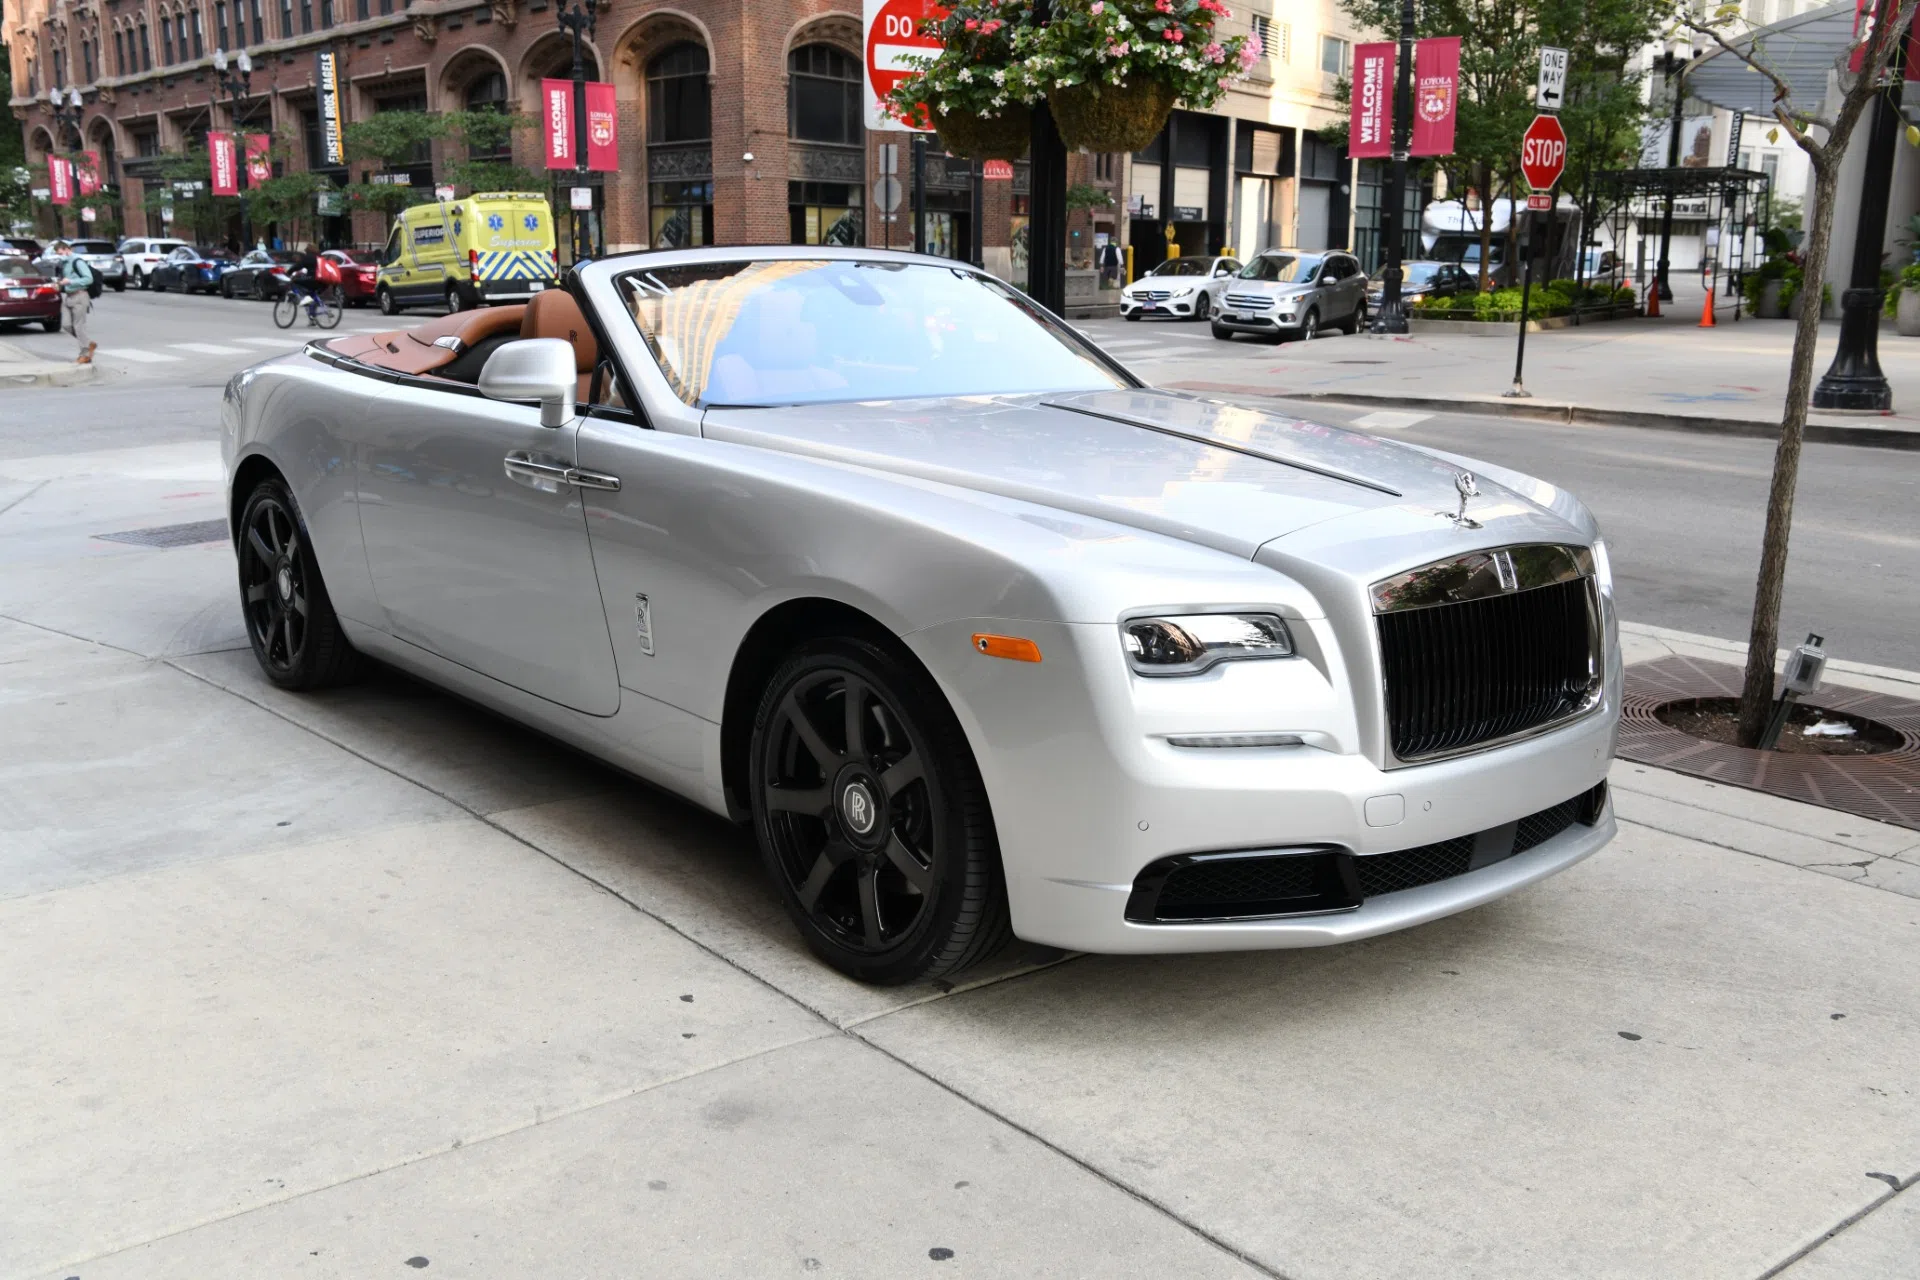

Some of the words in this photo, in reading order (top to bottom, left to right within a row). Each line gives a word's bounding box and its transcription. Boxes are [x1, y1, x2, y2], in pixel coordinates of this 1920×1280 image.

[886, 14, 913, 38] DO
[321, 53, 334, 91] BAGELS
[1544, 53, 1564, 69] ONE
[1420, 77, 1452, 86] LOYOLA
[1542, 70, 1563, 85] WAY
[1361, 57, 1377, 144] WELCOME
[550, 90, 563, 158] WELCOME
[590, 111, 613, 119] LOYOLA
[326, 120, 339, 163] EINSTEIN
[1728, 113, 1741, 165] ORDSTROM
[215, 139, 226, 188] WELCOME
[1525, 138, 1564, 167] STOP
[1530, 197, 1540, 207] ALL
[1540, 197, 1549, 207] WAY
[413, 227, 444, 239] SUPERIOR
